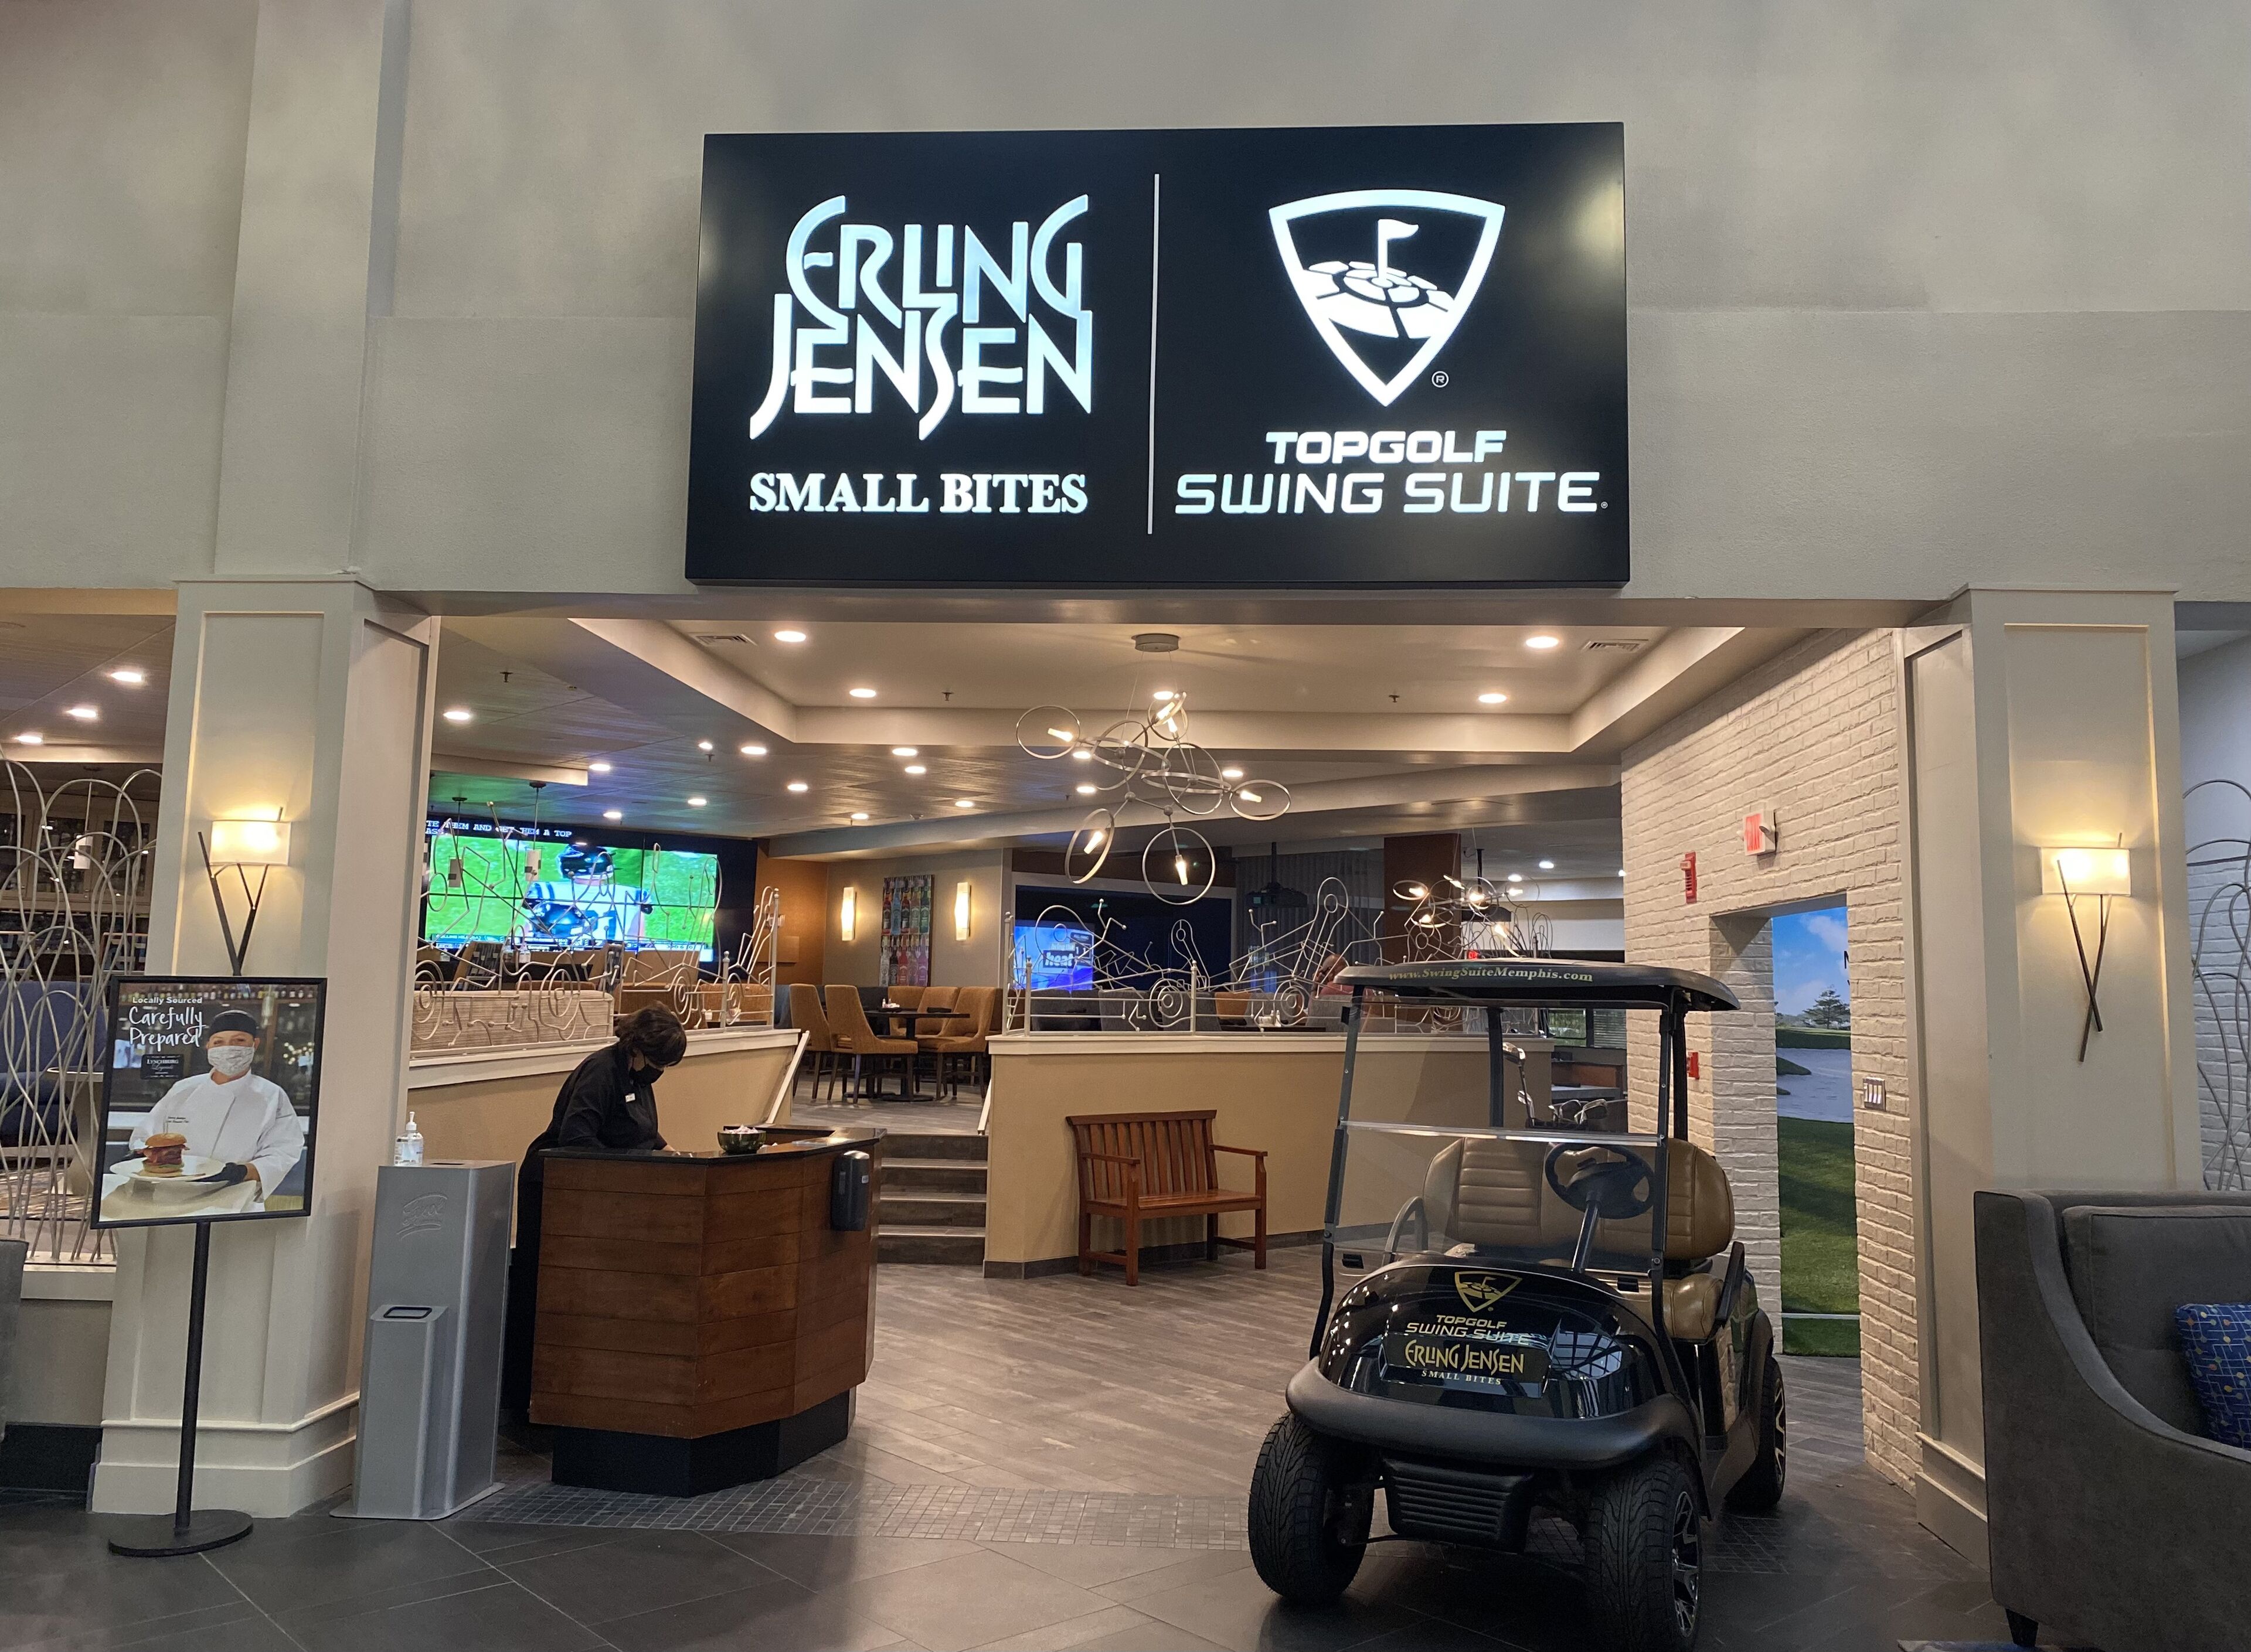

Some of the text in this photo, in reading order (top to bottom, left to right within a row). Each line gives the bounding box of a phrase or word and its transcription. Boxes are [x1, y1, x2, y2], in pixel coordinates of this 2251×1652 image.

[786, 195, 1089, 329] ERLING
[750, 293, 1093, 441] JENSEN
[1266, 430, 1507, 464] TOPGOLF
[750, 472, 1088, 514] SMALL BITES
[1175, 472, 1600, 514] SWING SUITE
[472, 824, 492, 832] AND
[554, 830, 572, 838] TOP
[1388, 966, 1593, 982] www.SwingSuiteMemphis.com
[132, 997, 164, 1005] Locally
[128, 1006, 207, 1038] Carefully
[130, 1026, 200, 1052] Prepared
[1405, 1322, 1530, 1346] SWING SUITE
[1436, 1314, 1507, 1329] TOPGOLF
[1405, 1339, 1524, 1376] ERLING JENSEN
[1421, 1370, 1501, 1385] SMALL BITES
